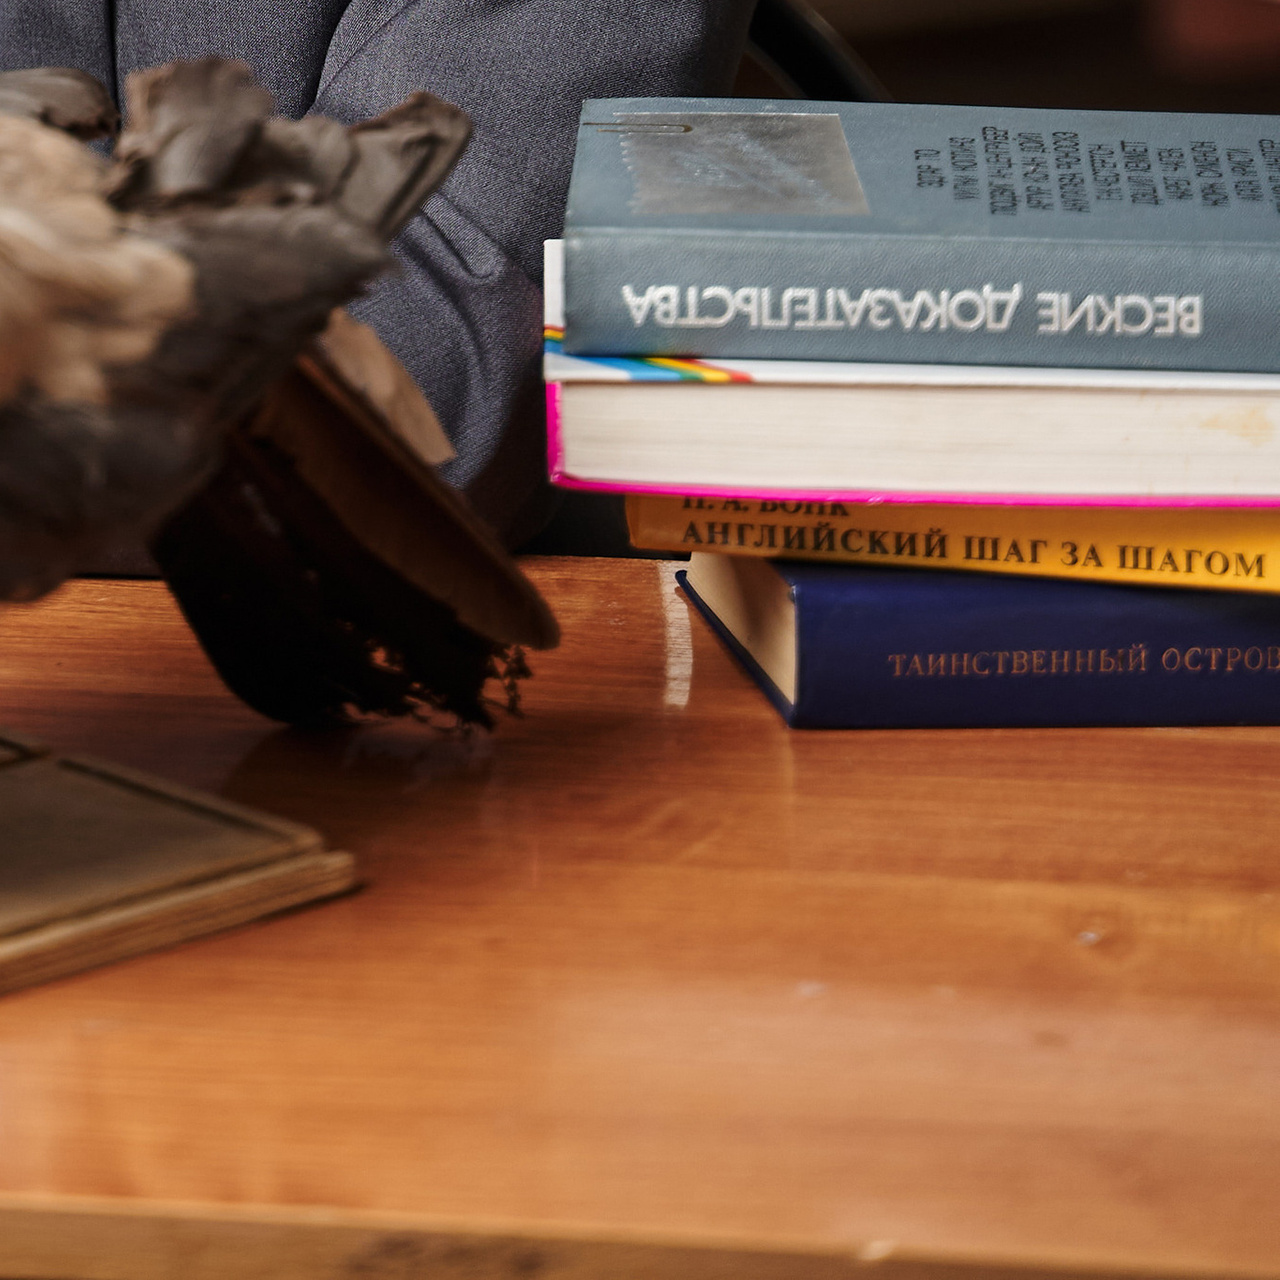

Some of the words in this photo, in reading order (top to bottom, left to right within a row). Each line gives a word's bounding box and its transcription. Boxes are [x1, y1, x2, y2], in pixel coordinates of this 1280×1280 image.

[914, 148, 941, 161] ПО
[948, 137, 978, 171] КОЛЛИНЗ
[1013, 132, 1050, 153] ДОЙЛ
[1189, 141, 1223, 178] СИМЕНОН
[1226, 148, 1258, 177] КРИСТИ
[917, 164, 947, 188] ЭДГАР
[1235, 180, 1263, 202] АГАТА
[1025, 186, 1054, 211] АРТУР
[621, 281, 1022, 334] ДОКАЗАТЕЛЬСТВА
[1036, 291, 1203, 336] ВЕСКИЕ
[682, 520, 948, 559] АНГЛИЙСКИЙ
[963, 535, 1048, 564] ШАГ
[1060, 541, 1104, 568] ЗА
[1116, 544, 1266, 578] ШАГОМ
[888, 642, 1148, 677] ТАИНСТВЕННЫЙ
[1161, 645, 1280, 672] ОСТРОВ
